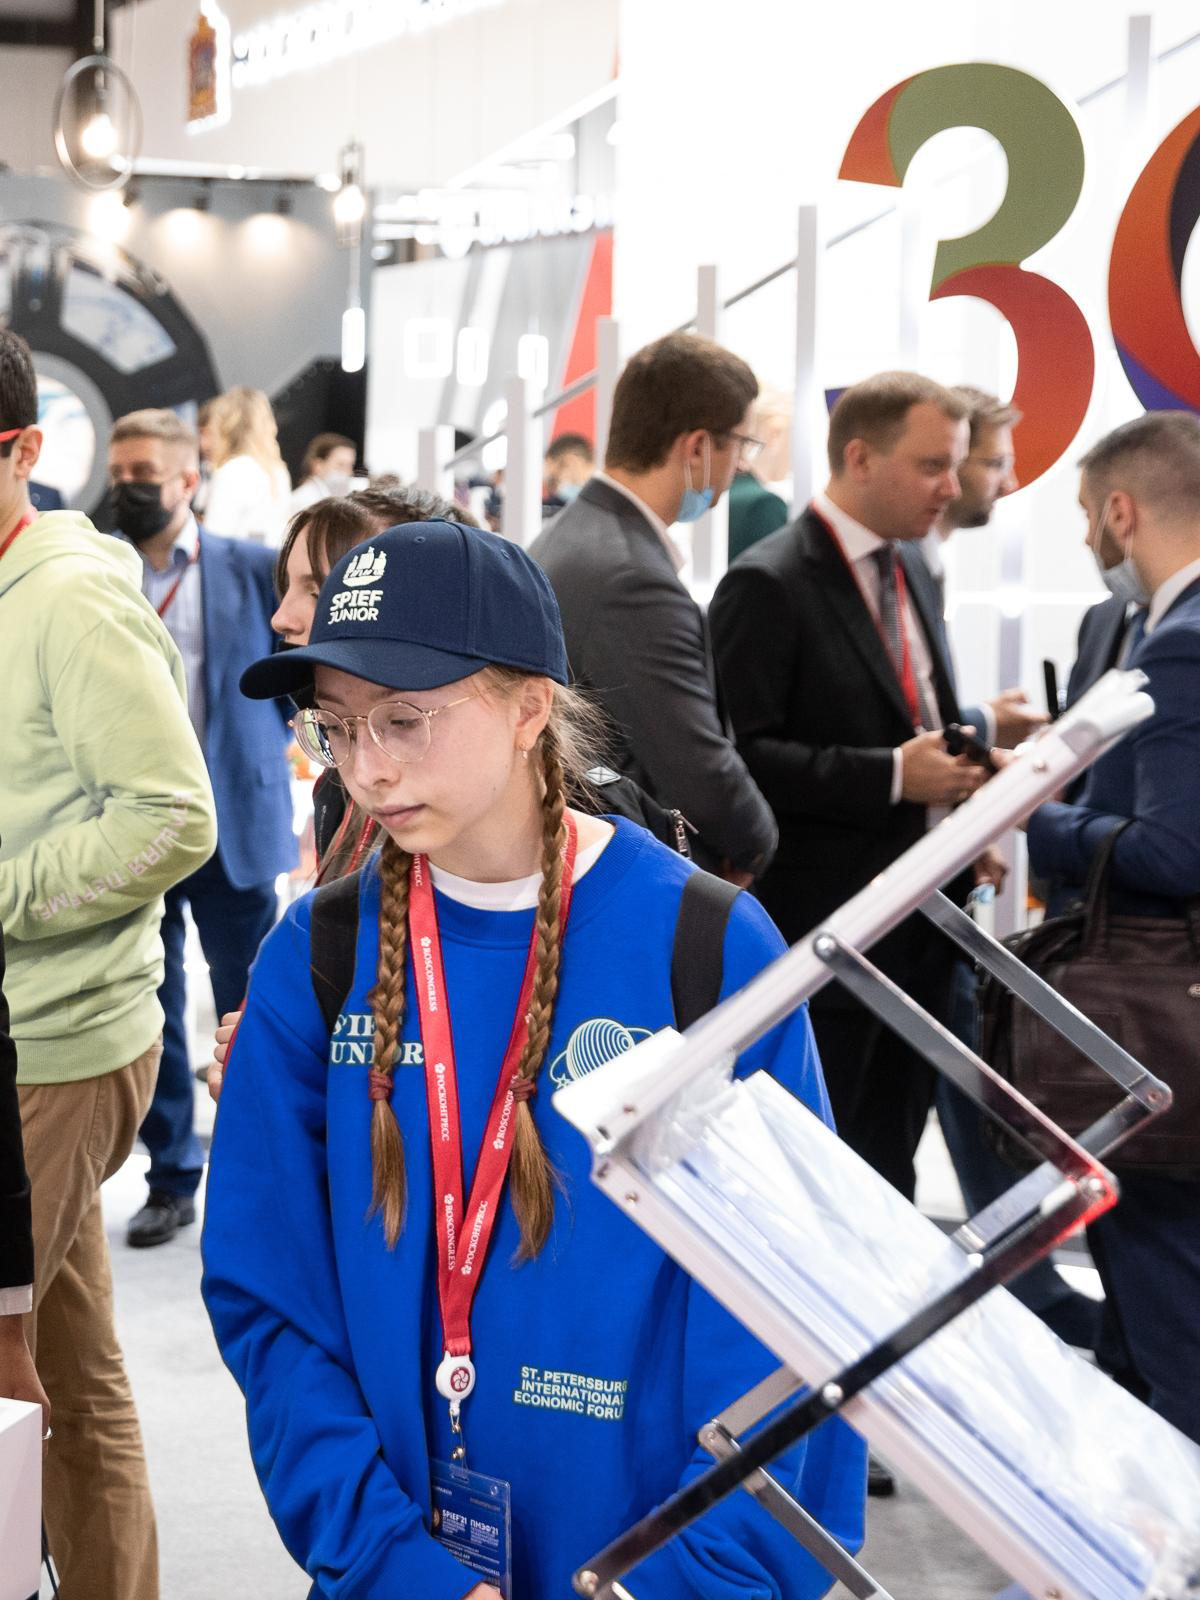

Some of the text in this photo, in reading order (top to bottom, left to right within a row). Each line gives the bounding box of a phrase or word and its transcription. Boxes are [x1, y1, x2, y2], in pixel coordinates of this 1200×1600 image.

[329, 589, 384, 612] SPIEF
[327, 606, 380, 625] JUNIOR
[423, 947, 438, 1012] ROSCONGRESS
[436, 1074, 450, 1141] РОСКОНГРЕСС
[445, 1204, 456, 1271] ROSCONGRESS
[464, 1200, 489, 1266] РОСКОНГРЕСС
[521, 1366, 628, 1392] ST. PETERSBURG
[521, 1379, 625, 1405] INTERNATIONAL
[514, 1390, 584, 1412] ECONOMIC
